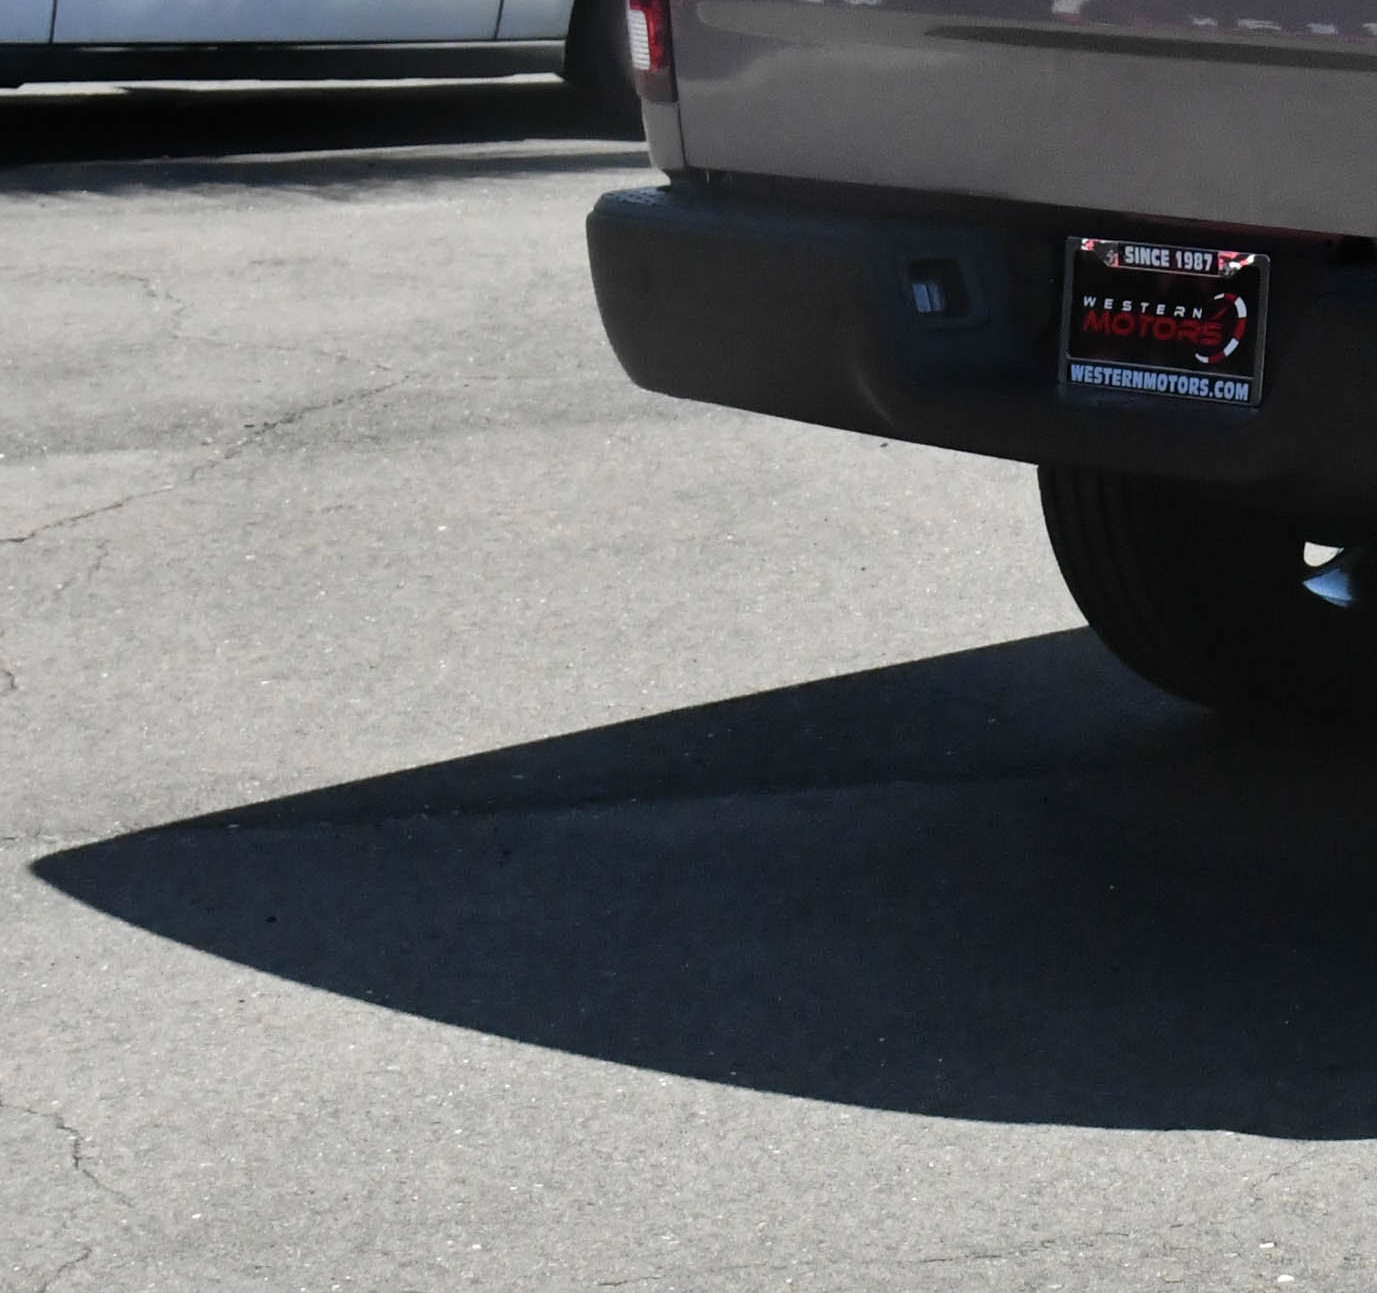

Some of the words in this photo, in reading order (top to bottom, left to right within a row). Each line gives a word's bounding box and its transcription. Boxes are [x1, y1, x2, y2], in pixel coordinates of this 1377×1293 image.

[1124, 246, 1170, 268] SINCE
[1175, 251, 1213, 272] 1987
[1083, 295, 1203, 320] WESTERN
[1082, 310, 1224, 345] MOTORS
[1070, 364, 1249, 401] WESTERNMOTORS.COM
